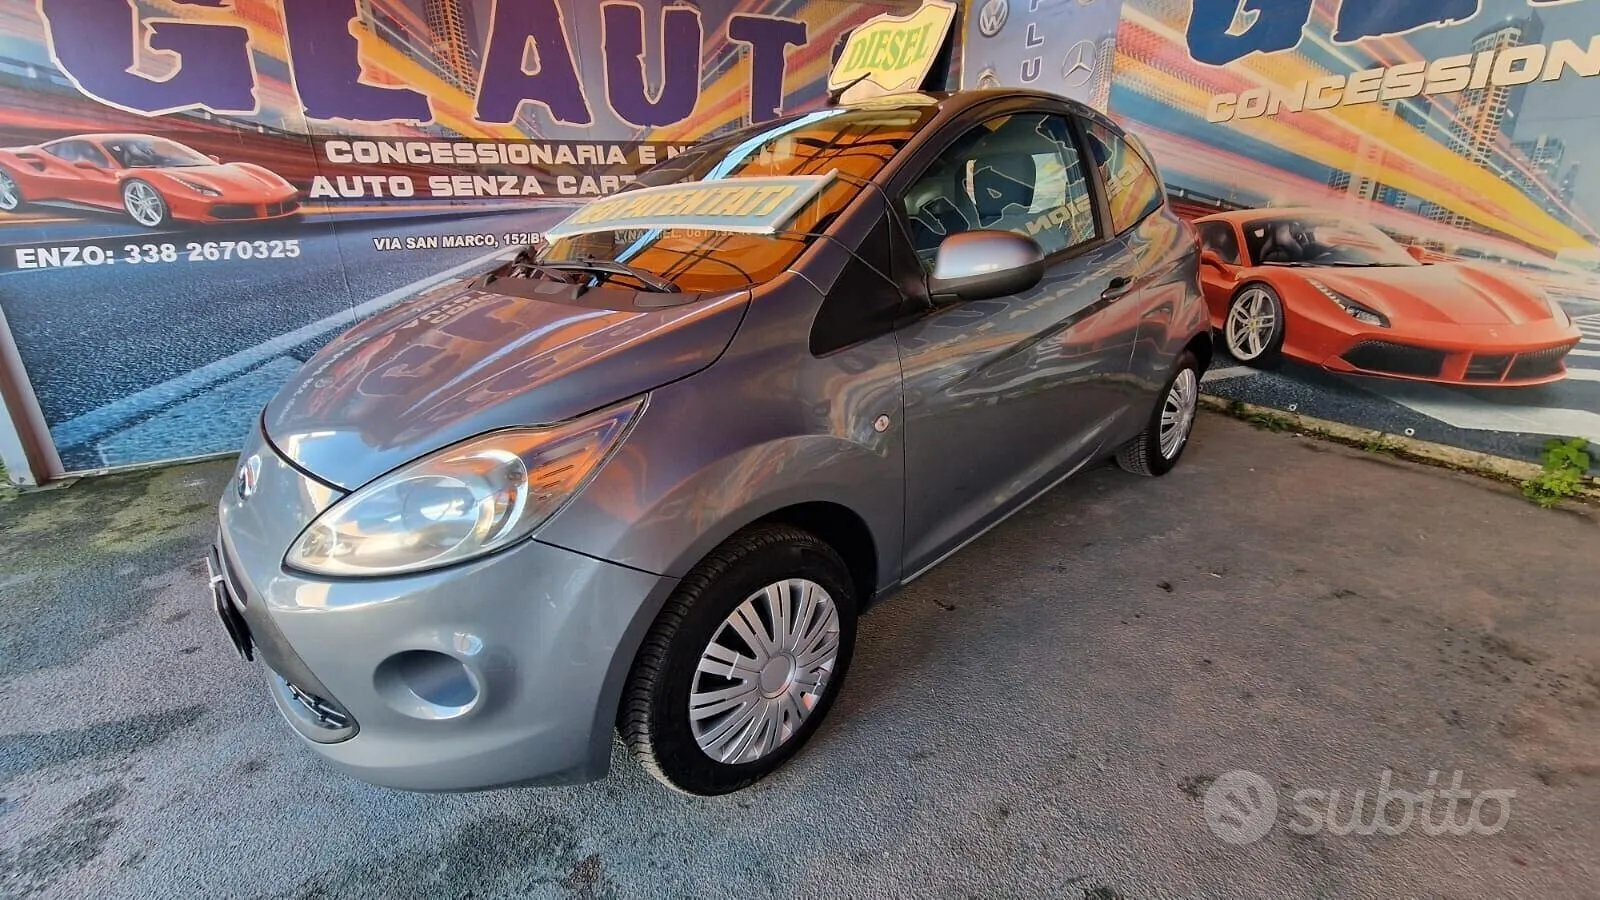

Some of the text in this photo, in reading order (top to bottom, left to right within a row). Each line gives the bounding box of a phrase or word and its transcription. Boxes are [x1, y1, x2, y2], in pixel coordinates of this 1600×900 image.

[843, 22, 933, 73] DIESEL
[325, 140, 628, 165] CONCESSIONARIA
[638, 145, 657, 165] E
[310, 174, 415, 199] AUTO
[429, 174, 545, 197] SENZA
[15, 239, 300, 269] ENZO: 338 2670325
[374, 237, 402, 251] VIA
[406, 236, 438, 250] SAN
[442, 234, 499, 249] MARCO,
